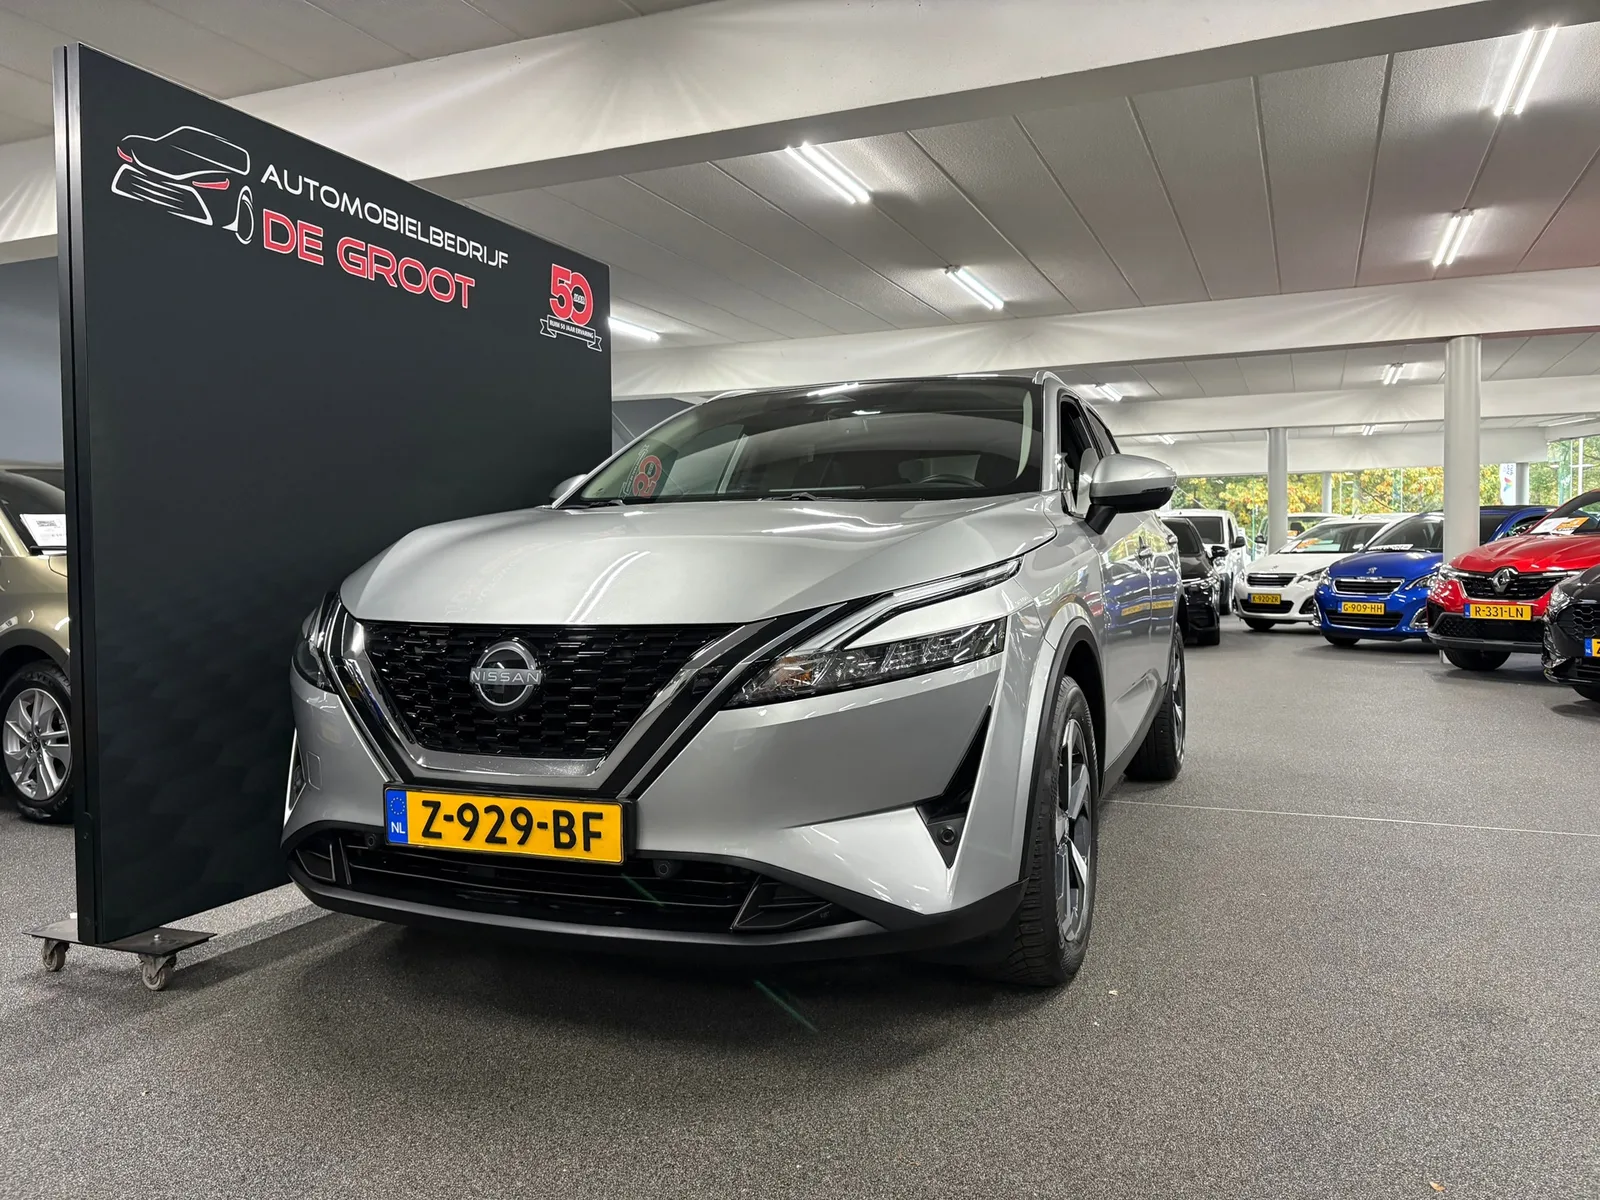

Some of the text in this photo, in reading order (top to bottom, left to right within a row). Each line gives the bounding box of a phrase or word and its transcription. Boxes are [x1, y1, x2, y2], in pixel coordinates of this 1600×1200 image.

[261, 164, 509, 269] AUTOMOBIELBEDRIJF
[262, 208, 476, 309] DE GROOT
[549, 263, 593, 326] 50
[1343, 604, 1382, 613] G-909-HH
[1474, 606, 1524, 618] R-331-LN
[470, 670, 541, 684] NISSAN
[390, 800, 604, 852] NL Z-929-BF
